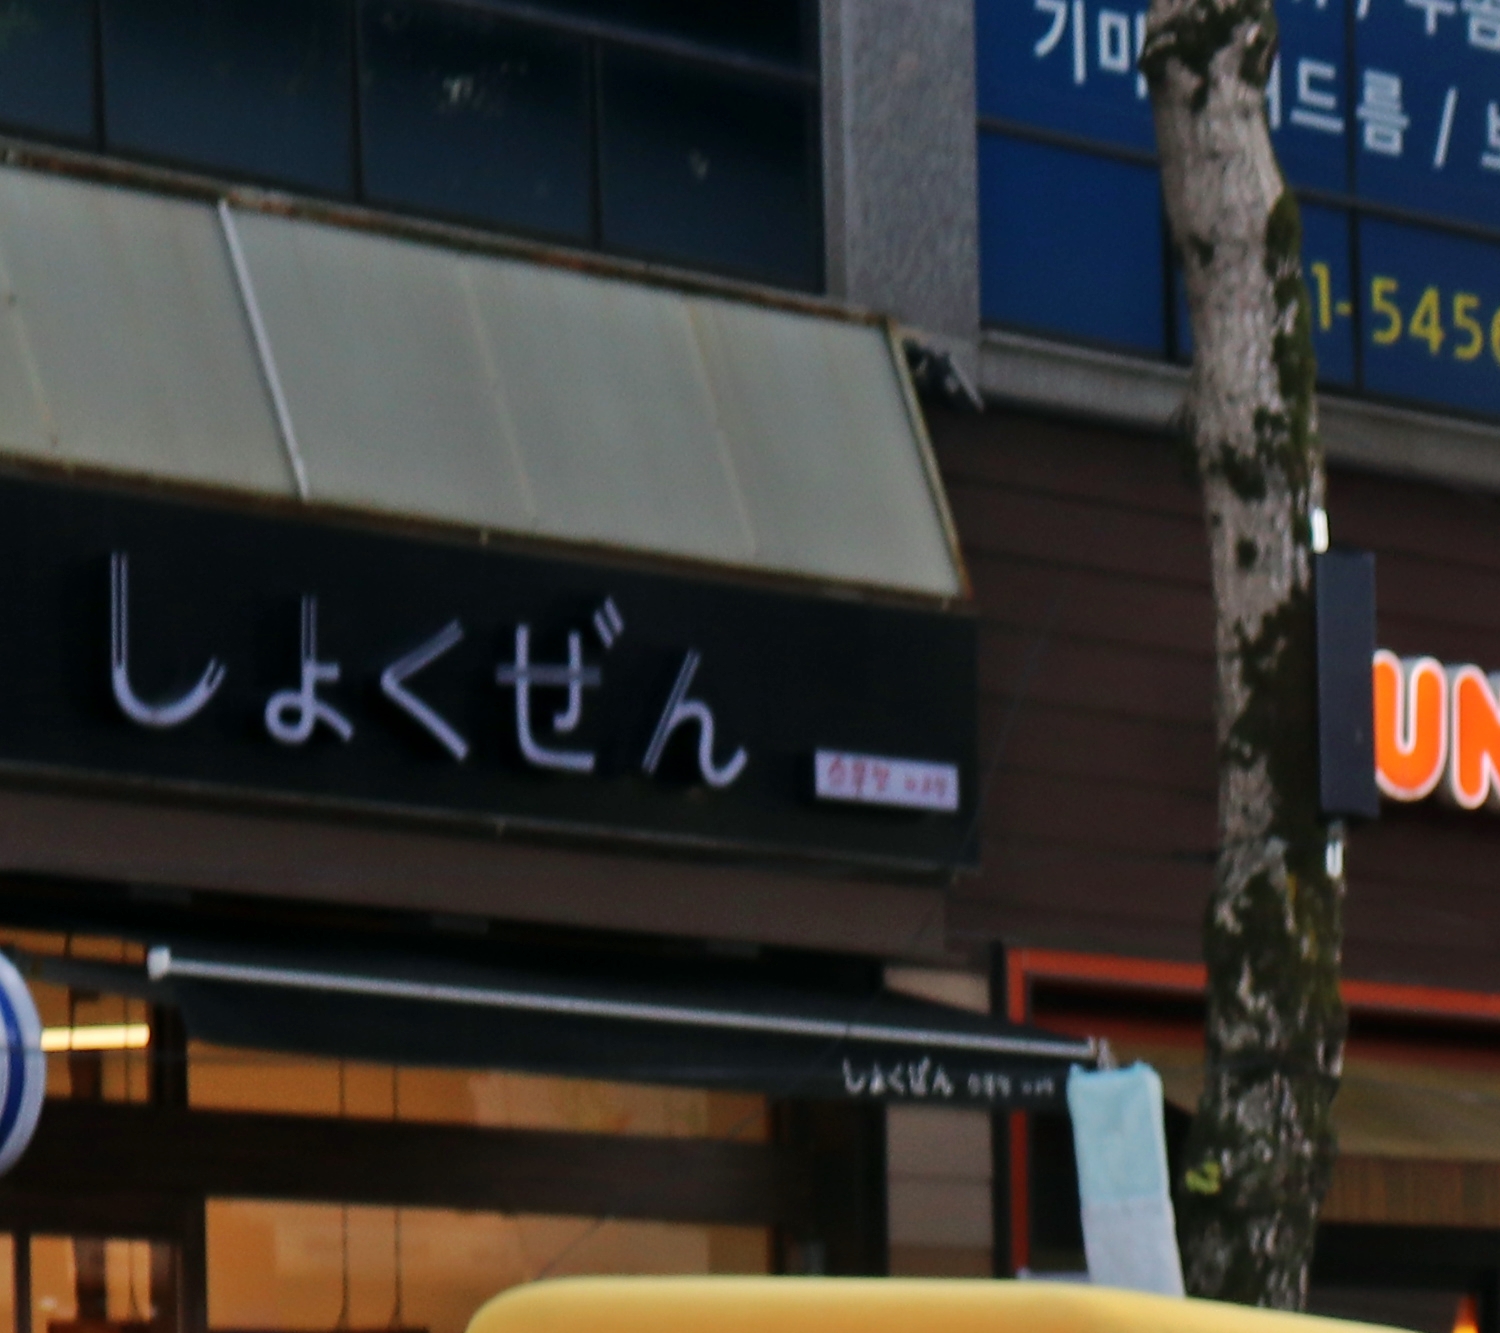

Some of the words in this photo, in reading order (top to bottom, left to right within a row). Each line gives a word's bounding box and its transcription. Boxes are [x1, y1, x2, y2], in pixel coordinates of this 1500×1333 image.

[110, 550, 749, 789] しょくぜん
